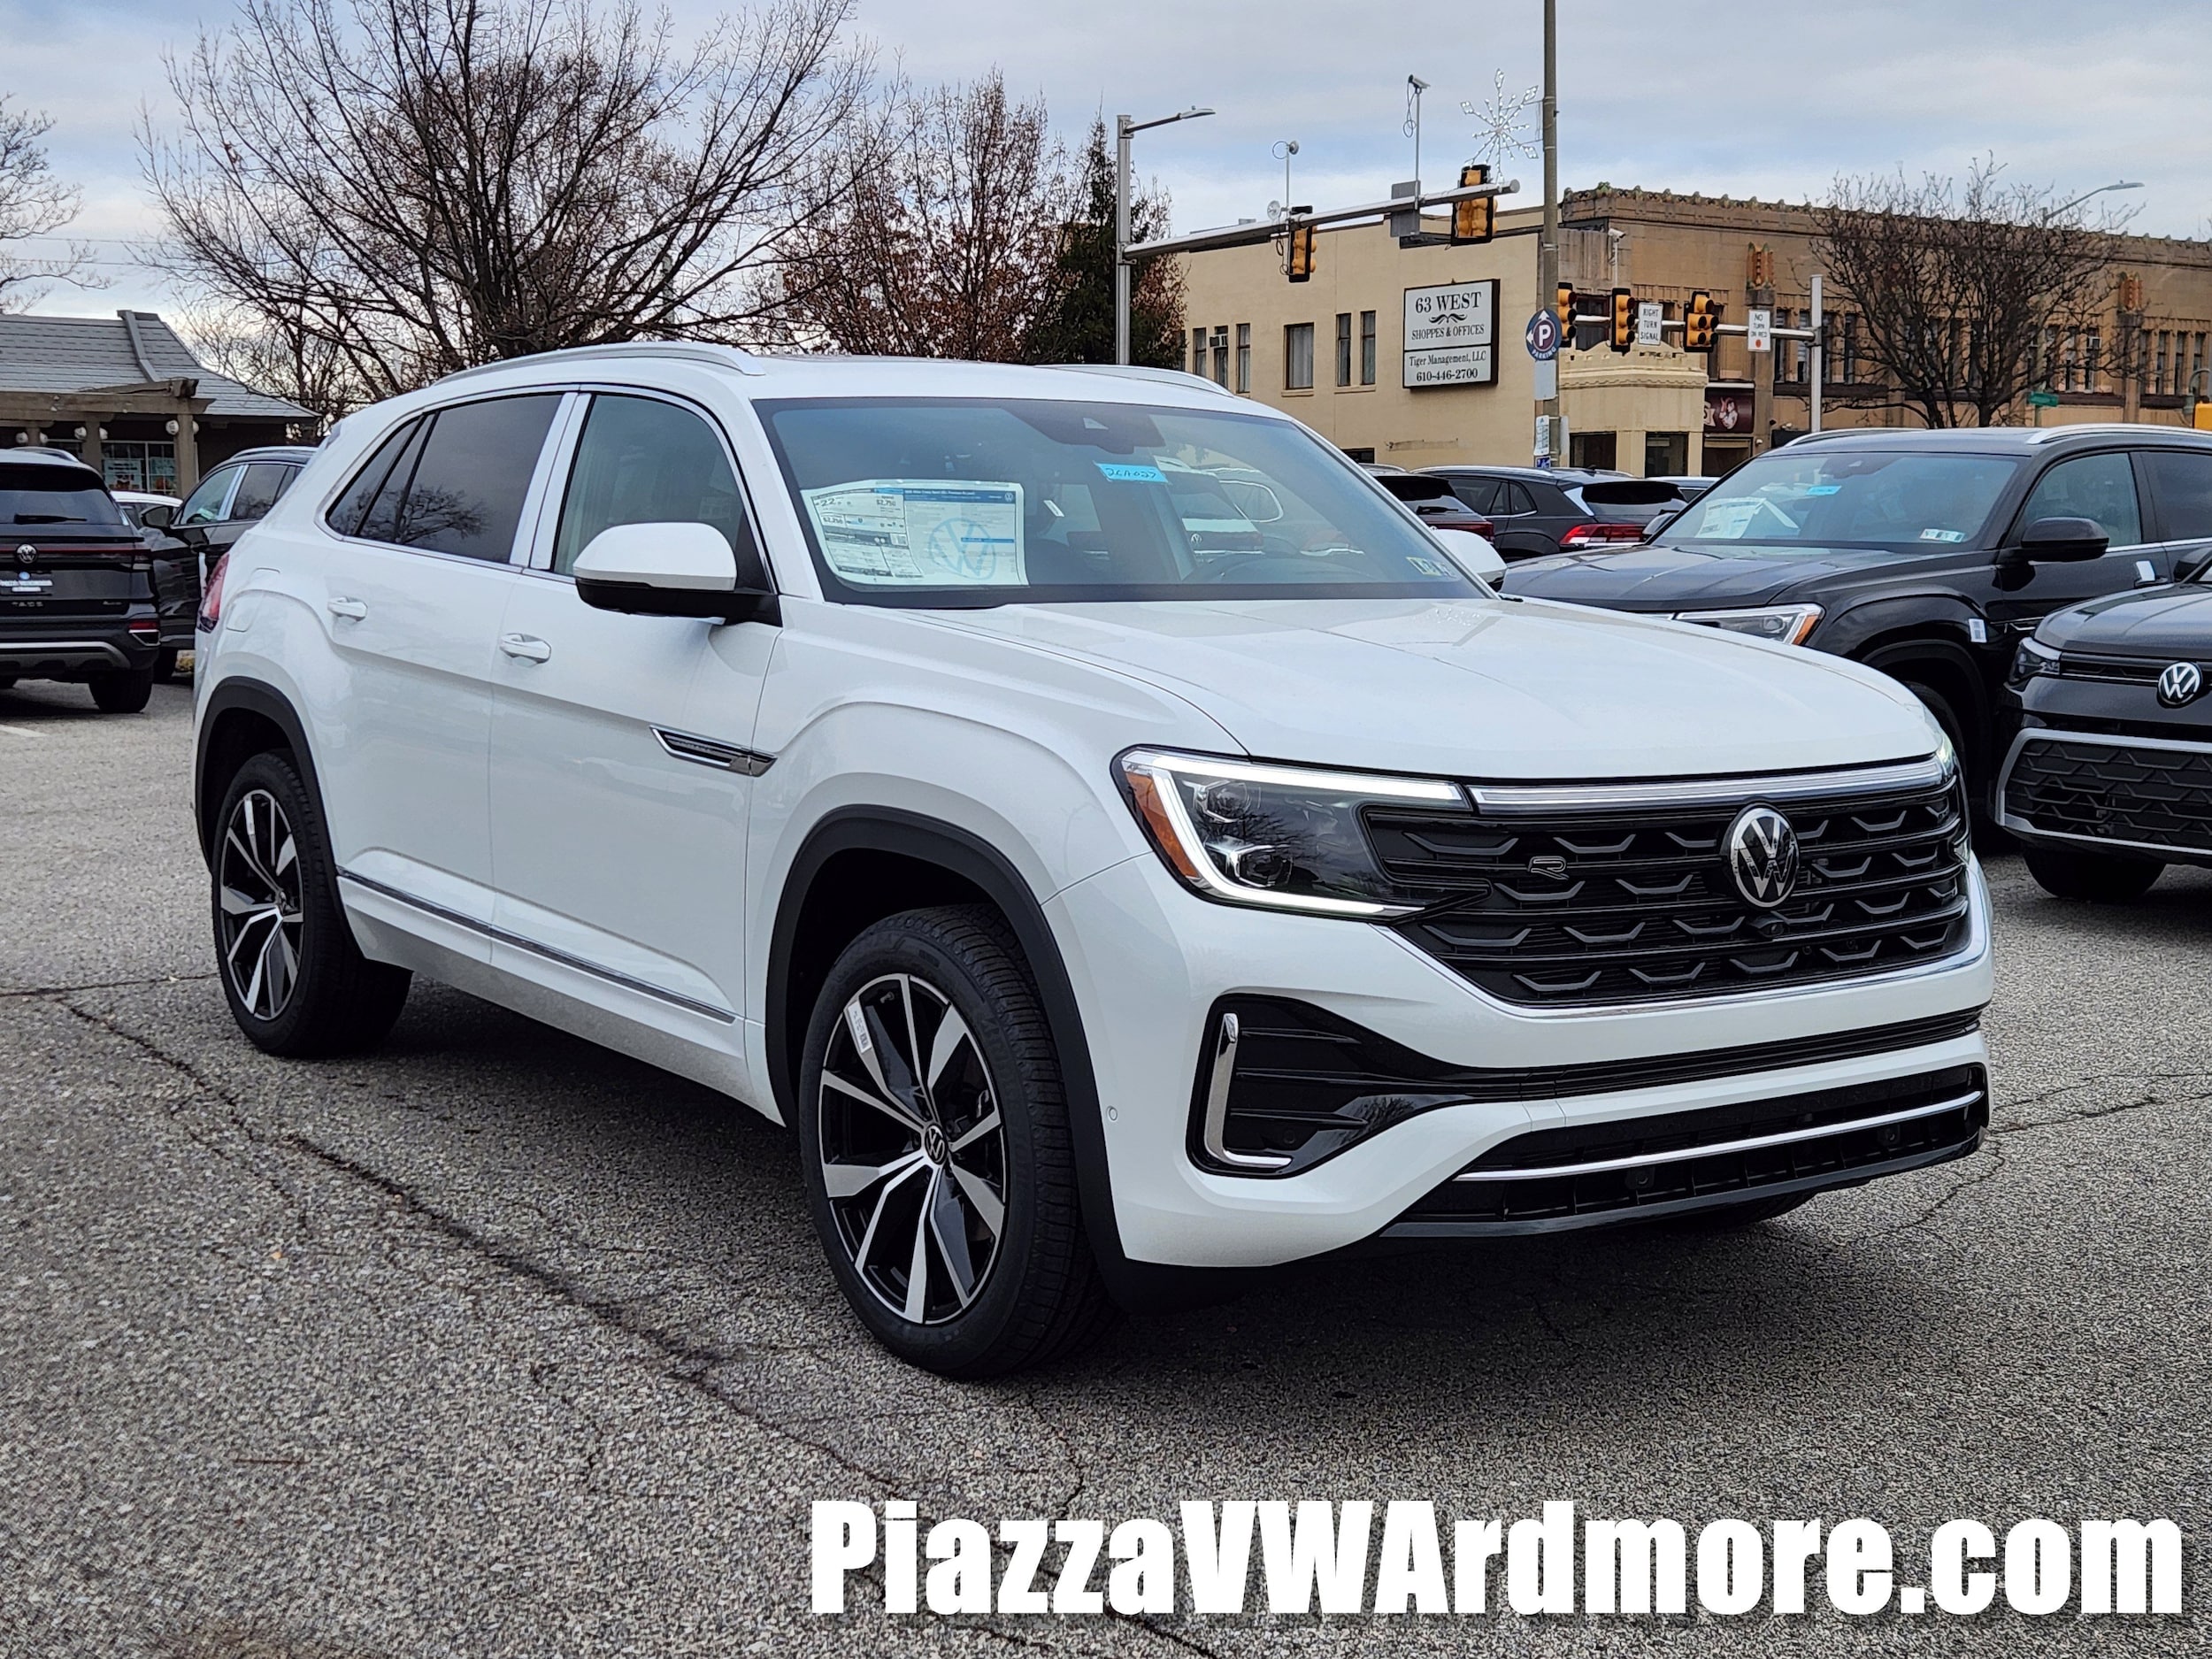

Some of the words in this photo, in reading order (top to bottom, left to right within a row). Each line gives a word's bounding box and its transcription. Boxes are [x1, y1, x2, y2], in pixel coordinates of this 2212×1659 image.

[1415, 296, 1432, 313] 63
[1436, 291, 1482, 312] WEST
[1642, 307, 1659, 318] RIGHT
[1754, 313, 1763, 322] NO
[1643, 320, 1657, 329] TURN
[1411, 326, 1445, 341] SHOPPES
[1446, 326, 1452, 337] &
[1452, 323, 1485, 337] OFFICES
[1539, 324, 1551, 347] P
[1640, 333, 1658, 342] SIGNAL
[1409, 356, 1427, 368] Tiger
[1427, 352, 1471, 366] Management,
[1471, 349, 1486, 362] LLC
[1532, 346, 1557, 359] PARKING
[1416, 367, 1479, 382] 610-446-2700
